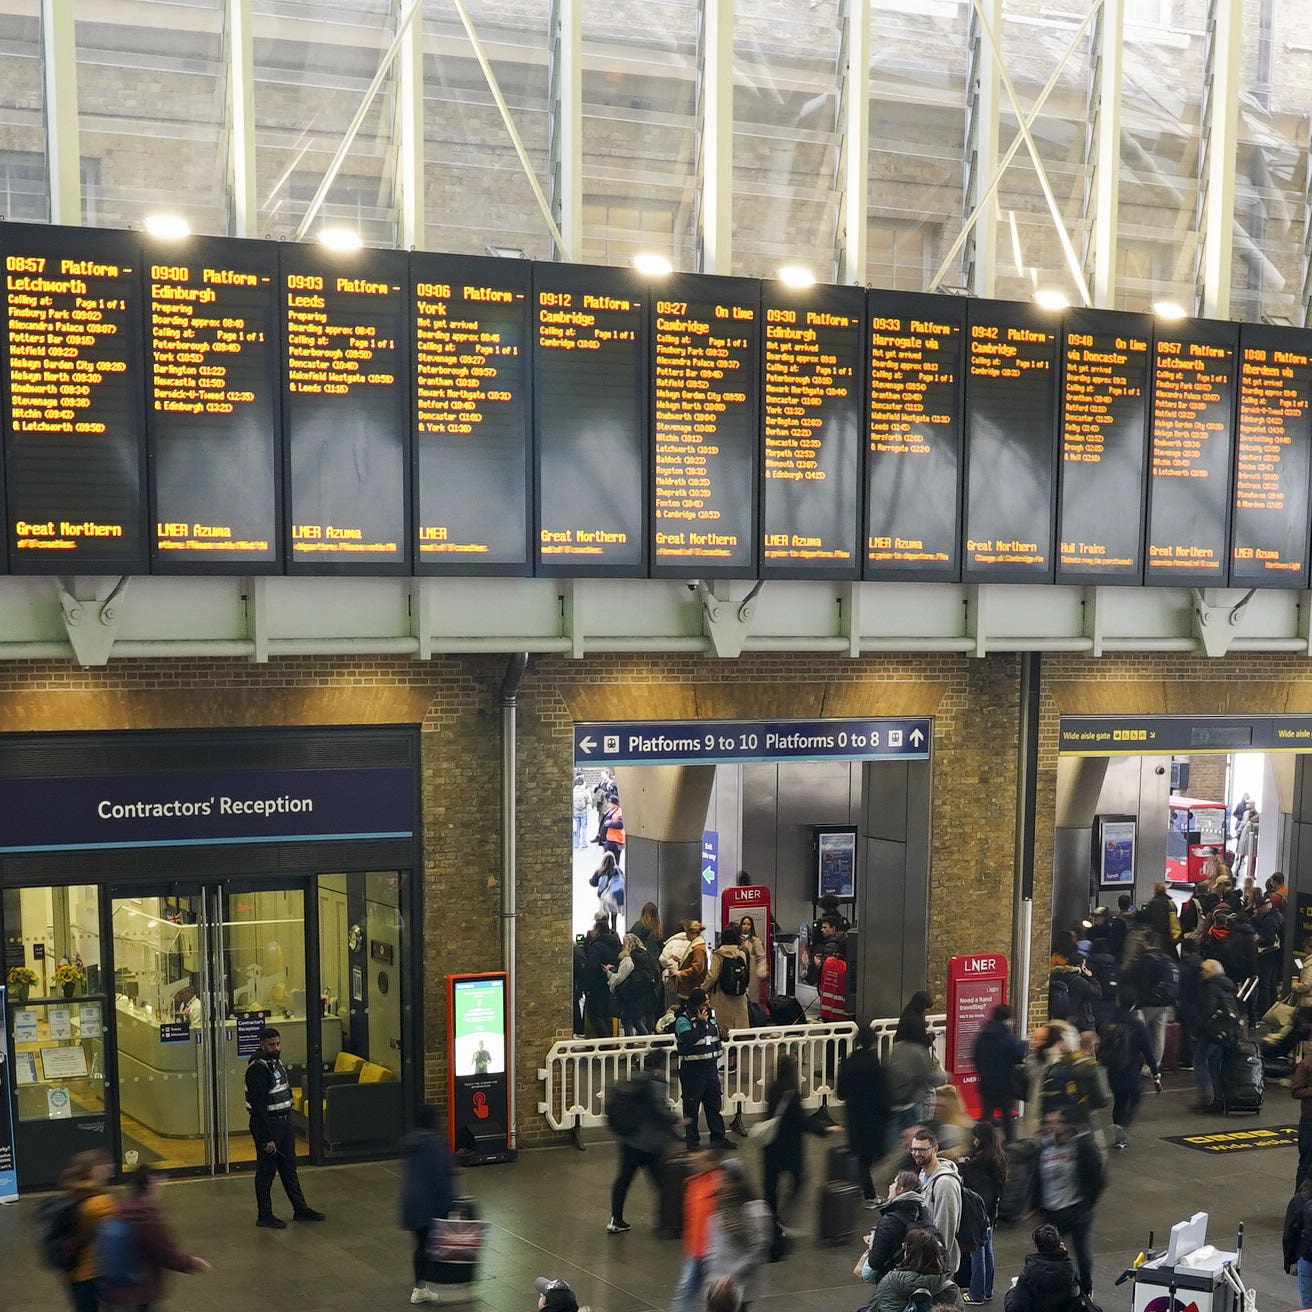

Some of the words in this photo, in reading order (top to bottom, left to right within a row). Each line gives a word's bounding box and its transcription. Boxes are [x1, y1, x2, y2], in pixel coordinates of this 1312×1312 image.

[7, 257, 45, 272] 08:57
[62, 260, 118, 277] Platform
[152, 266, 189, 281] 09:00
[8, 276, 86, 294] Letchworth
[417, 284, 450, 298] 09:06
[152, 285, 215, 303] Edinburgh
[540, 293, 571, 306] 09:12
[417, 301, 446, 315] York
[540, 310, 594, 327] Cambridge
[873, 318, 900, 331] 09:33
[873, 334, 922, 349] Harrogate
[925, 338, 938, 349] via
[1068, 350, 1080, 360] via
[1084, 350, 1127, 364] Doncaster
[1245, 349, 1266, 361] 10:00
[1243, 364, 1279, 376] Aberdeen
[1282, 367, 1293, 377] via
[1080, 545, 1105, 554] Trains
[766, 731, 834, 749] Platforms
[838, 732, 848, 747] 0
[851, 733, 866, 747] to
[870, 731, 880, 746] 8
[1063, 732, 1080, 740] Wide
[1081, 731, 1095, 740] aisle
[1096, 731, 1110, 741] gate
[1278, 730, 1295, 738] Wide
[1296, 729, 1310, 738] aisle
[629, 734, 701, 752] Platforms
[704, 734, 715, 750] 9
[719, 736, 735, 750] to
[739, 734, 758, 750] 10
[97, 796, 215, 820] Contractors'
[220, 795, 313, 818] Reception
[735, 889, 761, 900] LNER
[965, 959, 996, 972] LNER
[959, 1003, 987, 1011] travelling?
